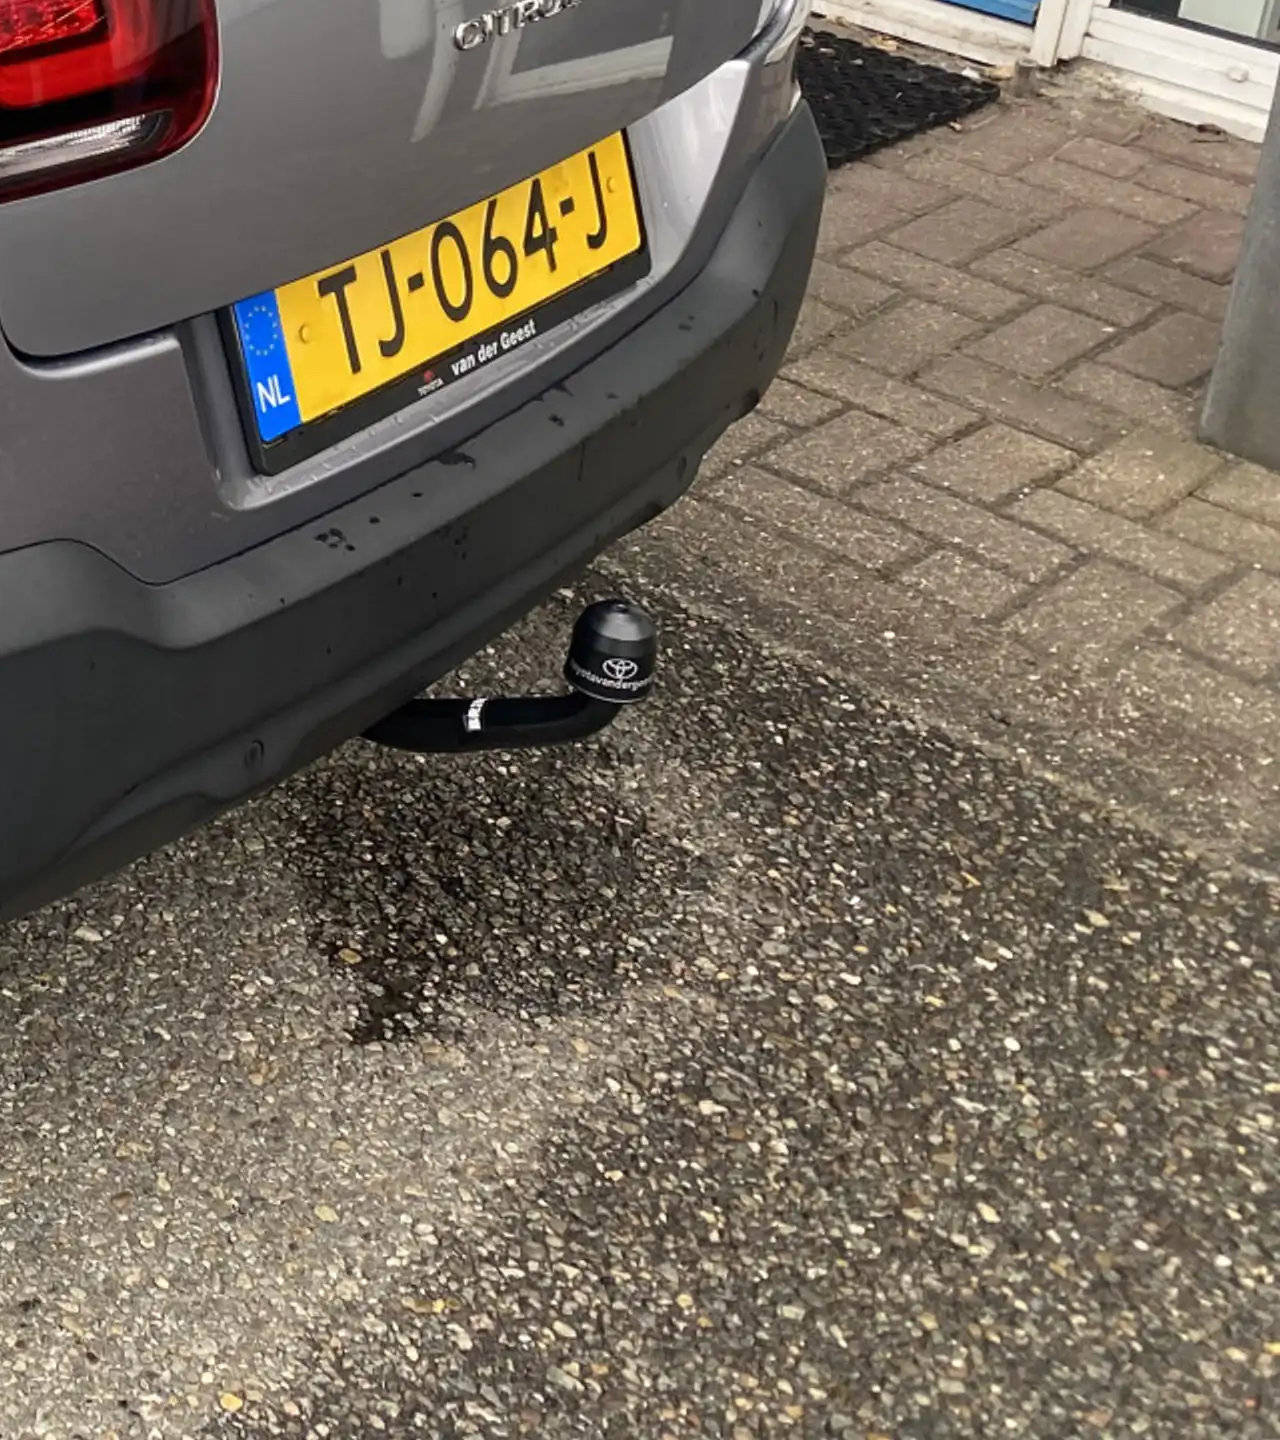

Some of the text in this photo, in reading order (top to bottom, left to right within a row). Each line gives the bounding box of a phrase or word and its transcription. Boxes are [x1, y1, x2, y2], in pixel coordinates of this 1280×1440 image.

[317, 151, 609, 375] TJ-064-J
[449, 353, 477, 377] van
[477, 341, 499, 363] der
[499, 318, 538, 350] Geest
[255, 374, 292, 413] NL
